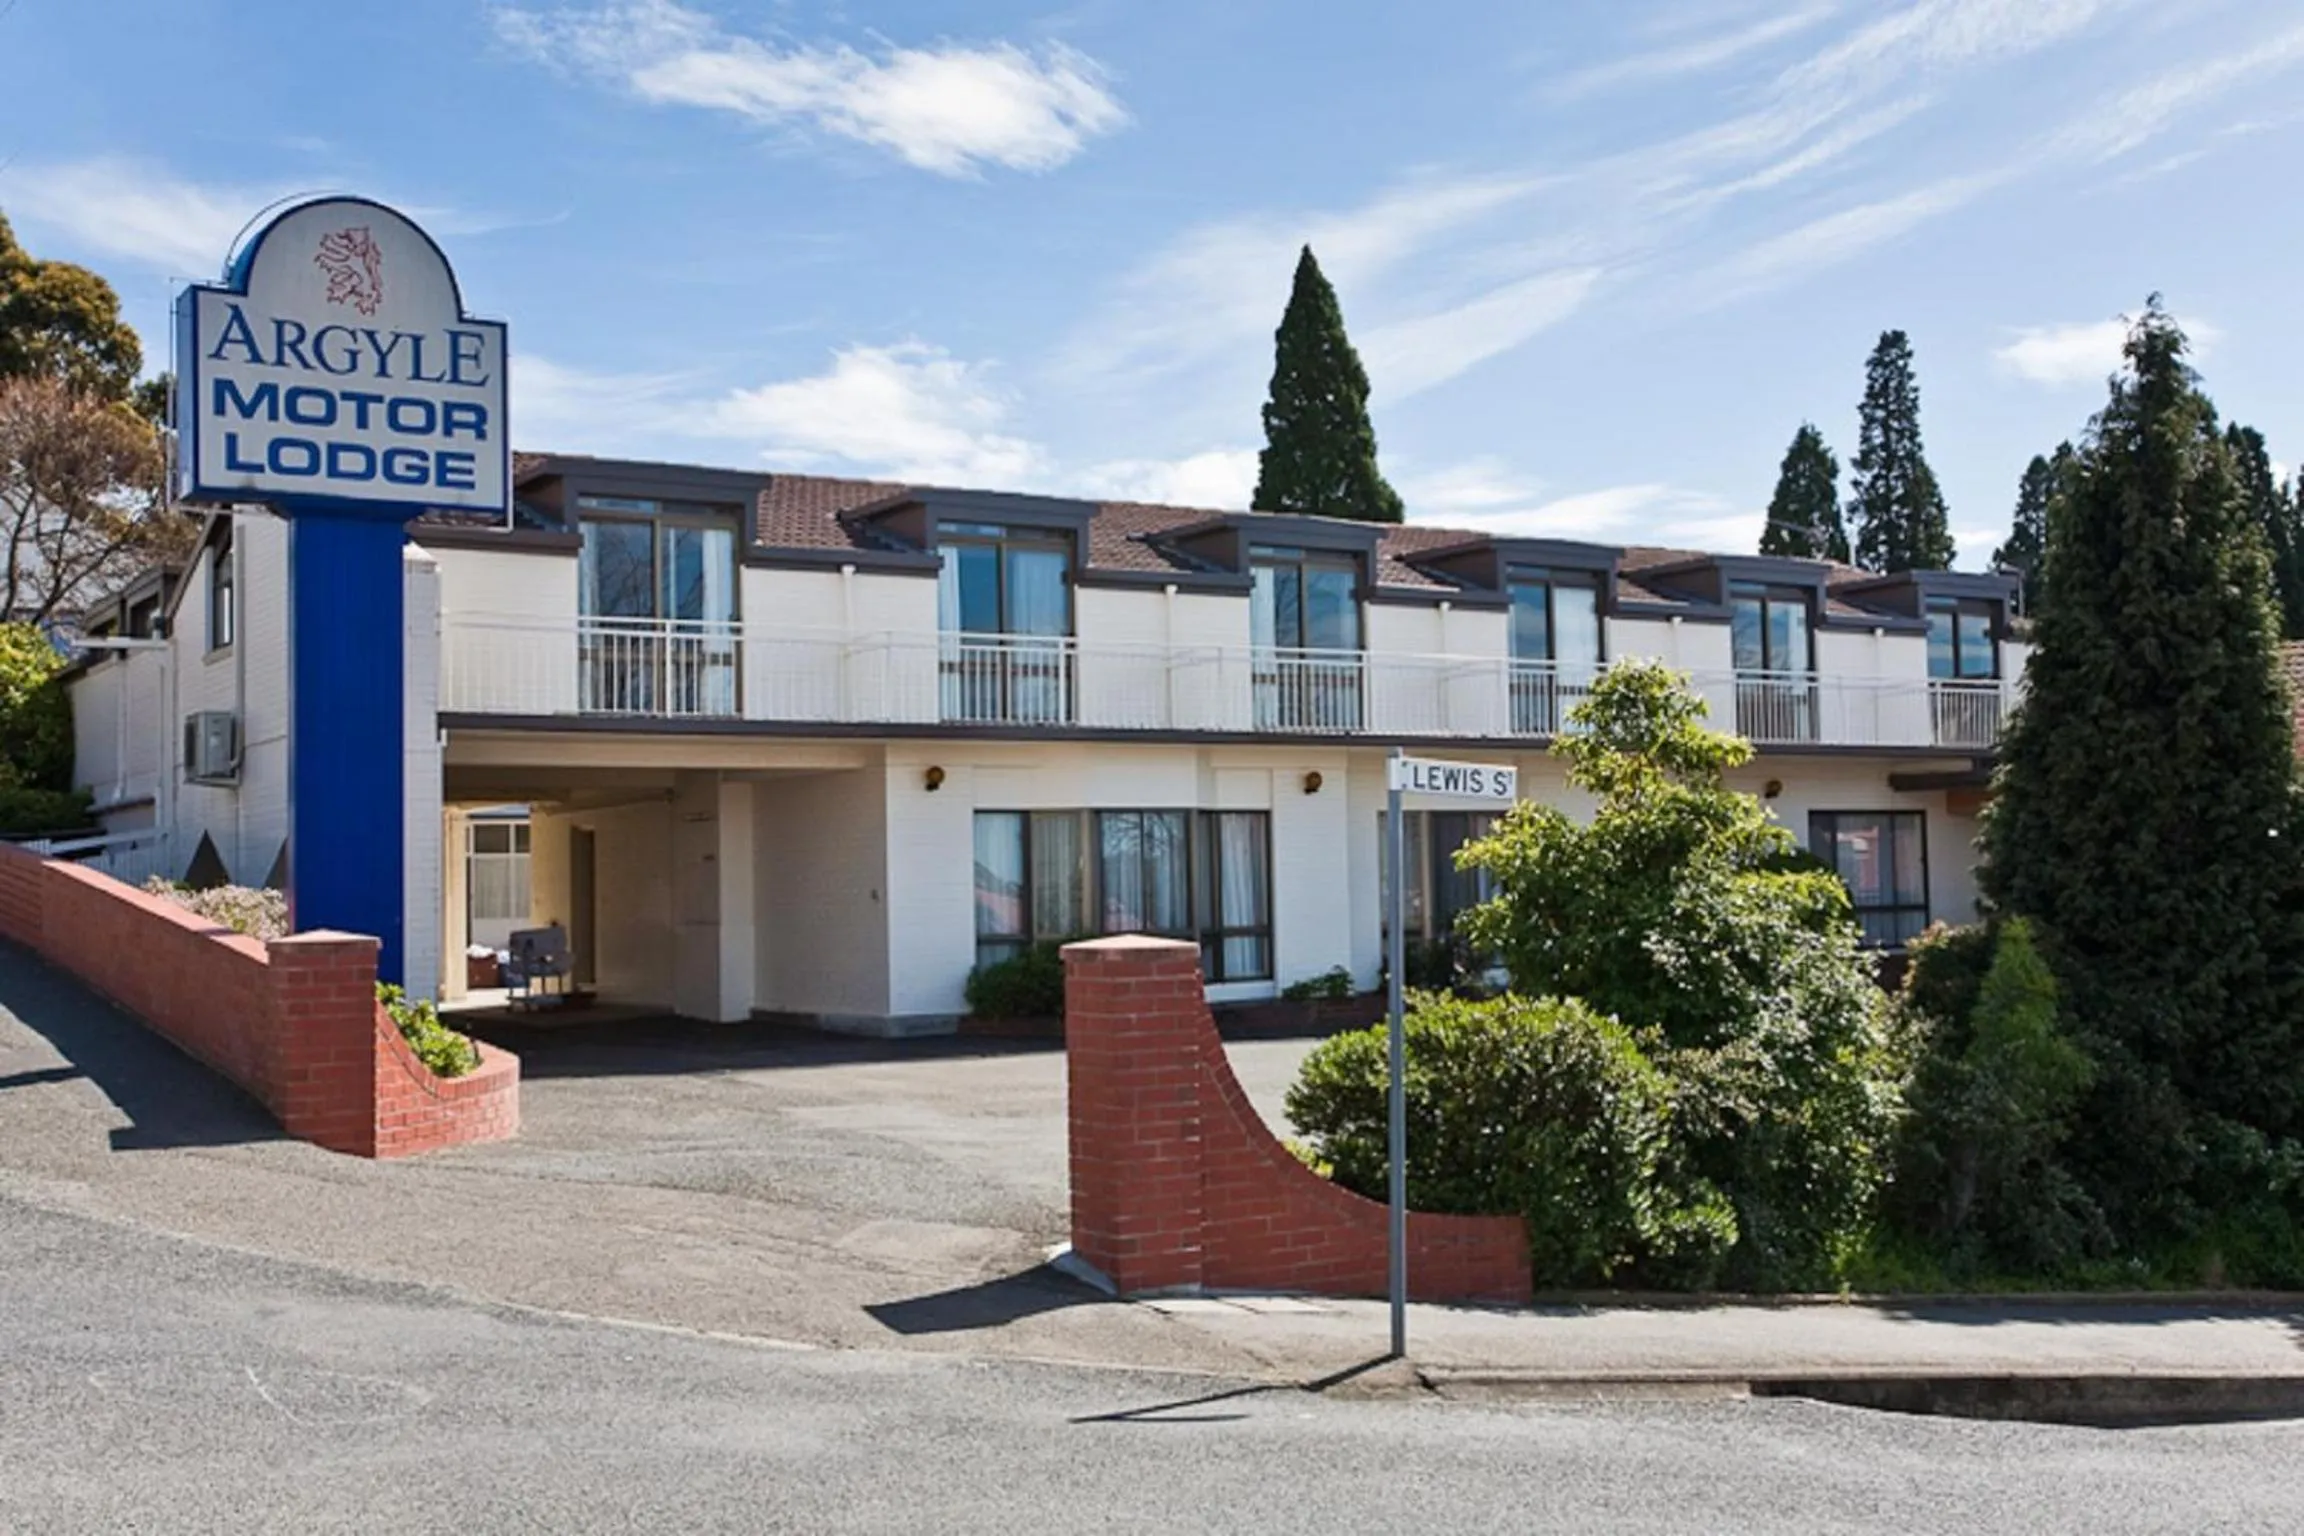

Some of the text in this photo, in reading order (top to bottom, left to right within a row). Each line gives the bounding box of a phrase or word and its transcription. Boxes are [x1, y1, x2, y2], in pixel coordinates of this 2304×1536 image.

[208, 302, 491, 388] ARGYLE
[213, 378, 489, 441] MOTOR
[225, 432, 477, 490] LODGE
[1413, 765, 1484, 793] LEWIS
